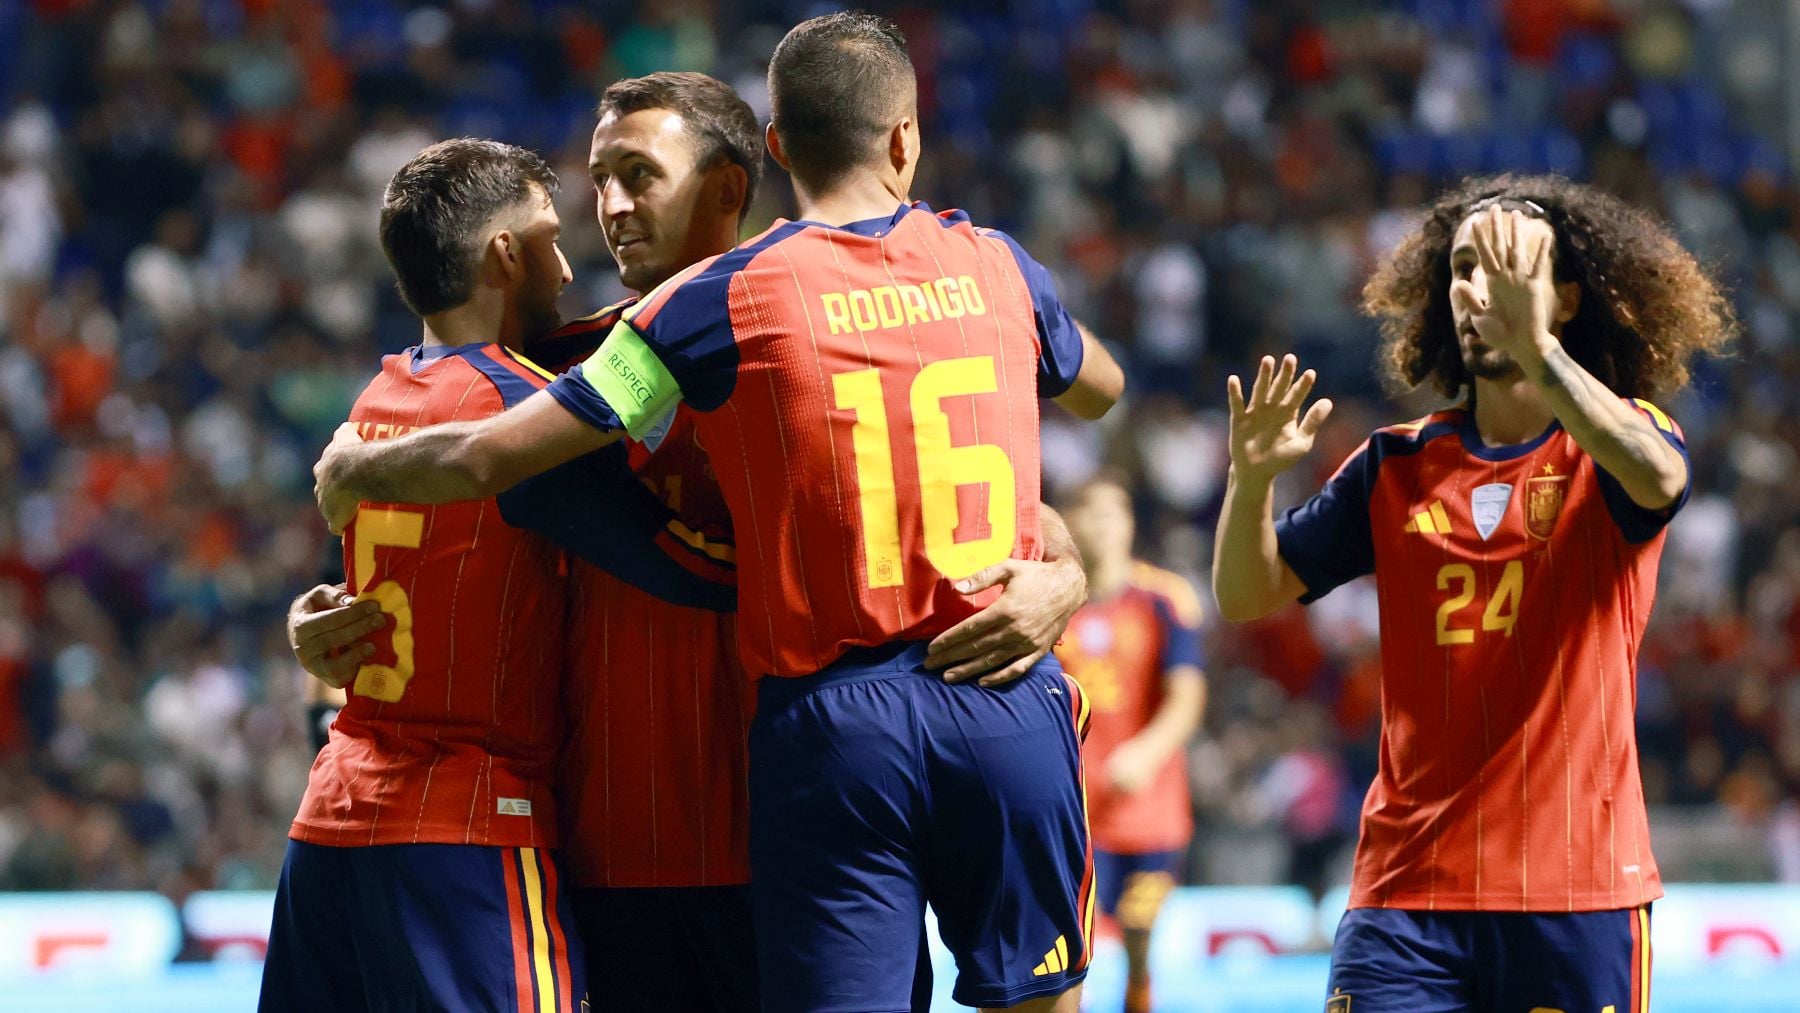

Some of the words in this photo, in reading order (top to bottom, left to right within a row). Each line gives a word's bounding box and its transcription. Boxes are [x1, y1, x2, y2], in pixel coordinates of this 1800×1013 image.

[820, 275, 986, 335] RODRIGO
[608, 353, 653, 404] RESPECT
[832, 355, 1017, 590] 16
[353, 508, 425, 703] 5
[1436, 560, 1524, 646] 24
